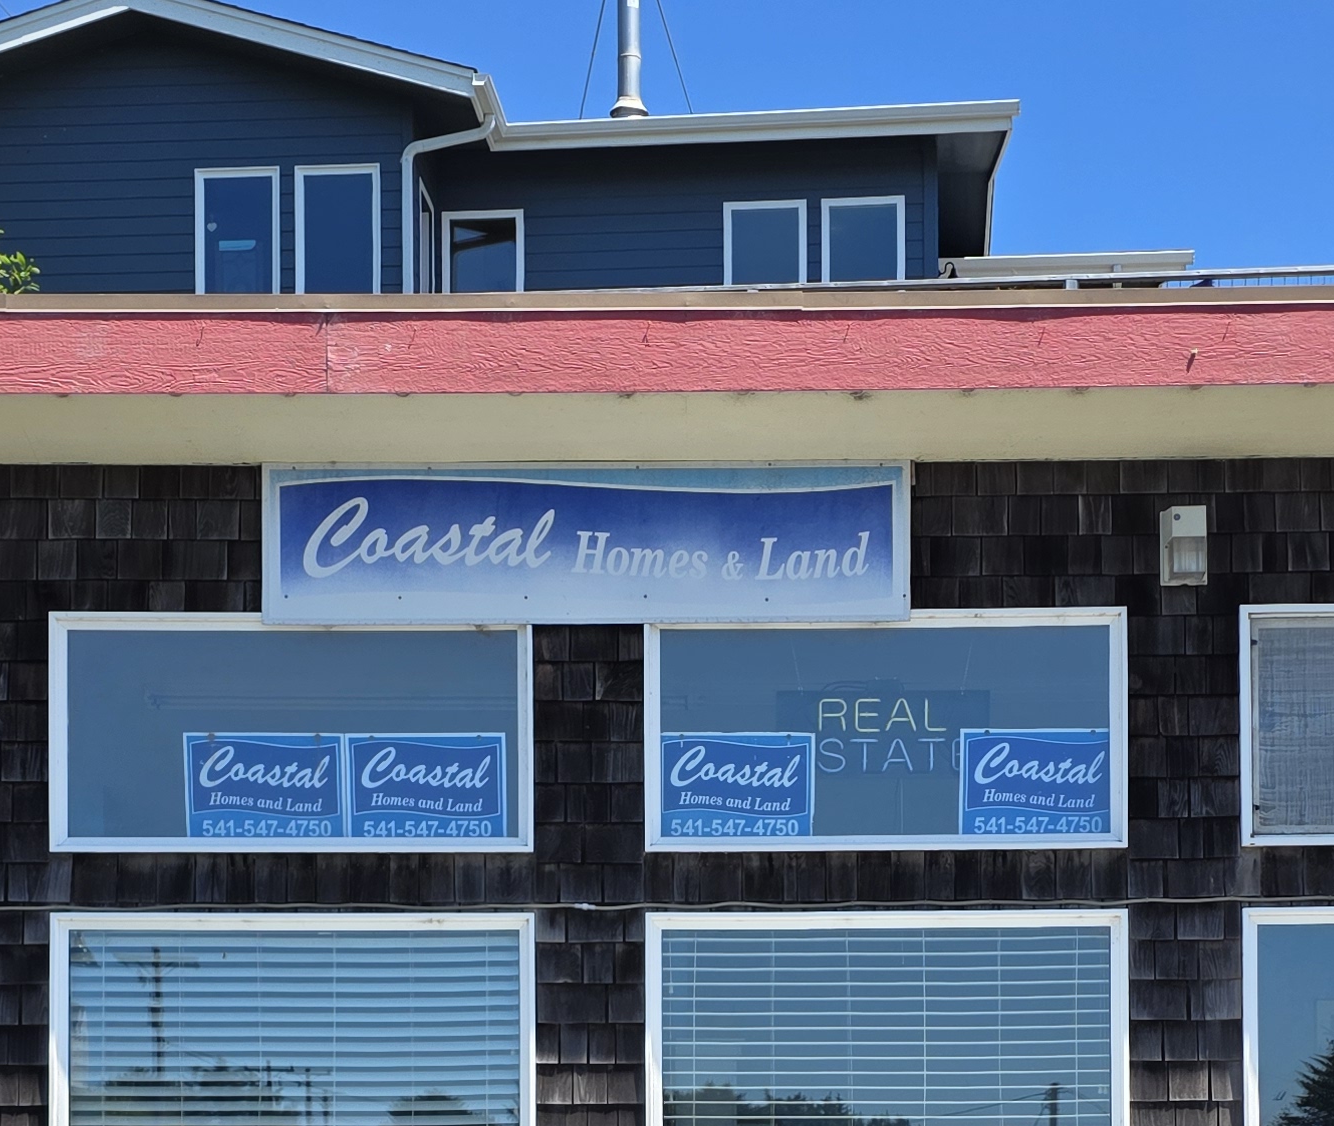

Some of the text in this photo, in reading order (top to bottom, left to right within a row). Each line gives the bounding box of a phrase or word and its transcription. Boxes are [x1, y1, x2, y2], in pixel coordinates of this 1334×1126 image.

[302, 496, 870, 581] Coastal Homes & Land
[817, 697, 948, 733] REAL
[198, 745, 331, 789] Coastal
[360, 746, 492, 789] Coastal
[669, 744, 801, 788] Coastal
[973, 741, 1106, 785] Coastal
[208, 791, 323, 813] Homes and Land
[370, 791, 483, 813] Homes and Land
[678, 790, 792, 812] Homes and Land
[982, 787, 1096, 809] Homes and Land
[201, 819, 332, 837] 541-547-4750
[363, 819, 492, 837] 541-547-4750
[670, 818, 800, 837] 541-547-4750
[973, 815, 1103, 834] 541-547-4750
